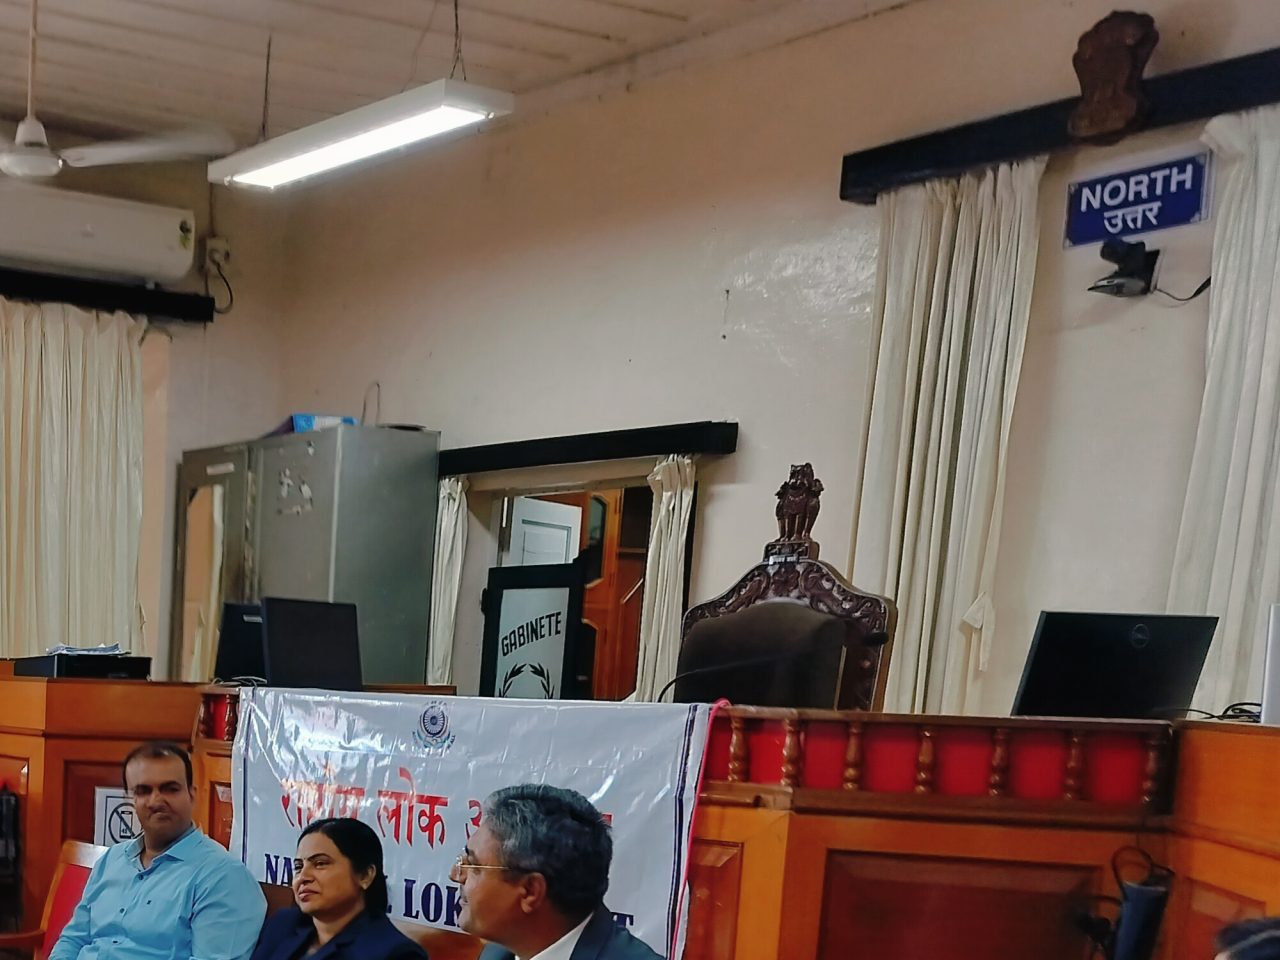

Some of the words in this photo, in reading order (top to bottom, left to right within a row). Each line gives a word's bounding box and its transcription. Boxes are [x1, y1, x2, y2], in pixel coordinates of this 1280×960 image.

[1081, 163, 1193, 213] NORTH
[1103, 200, 1162, 234] उत्तर
[501, 611, 562, 657] GABINETE
[377, 767, 448, 850] लोक
